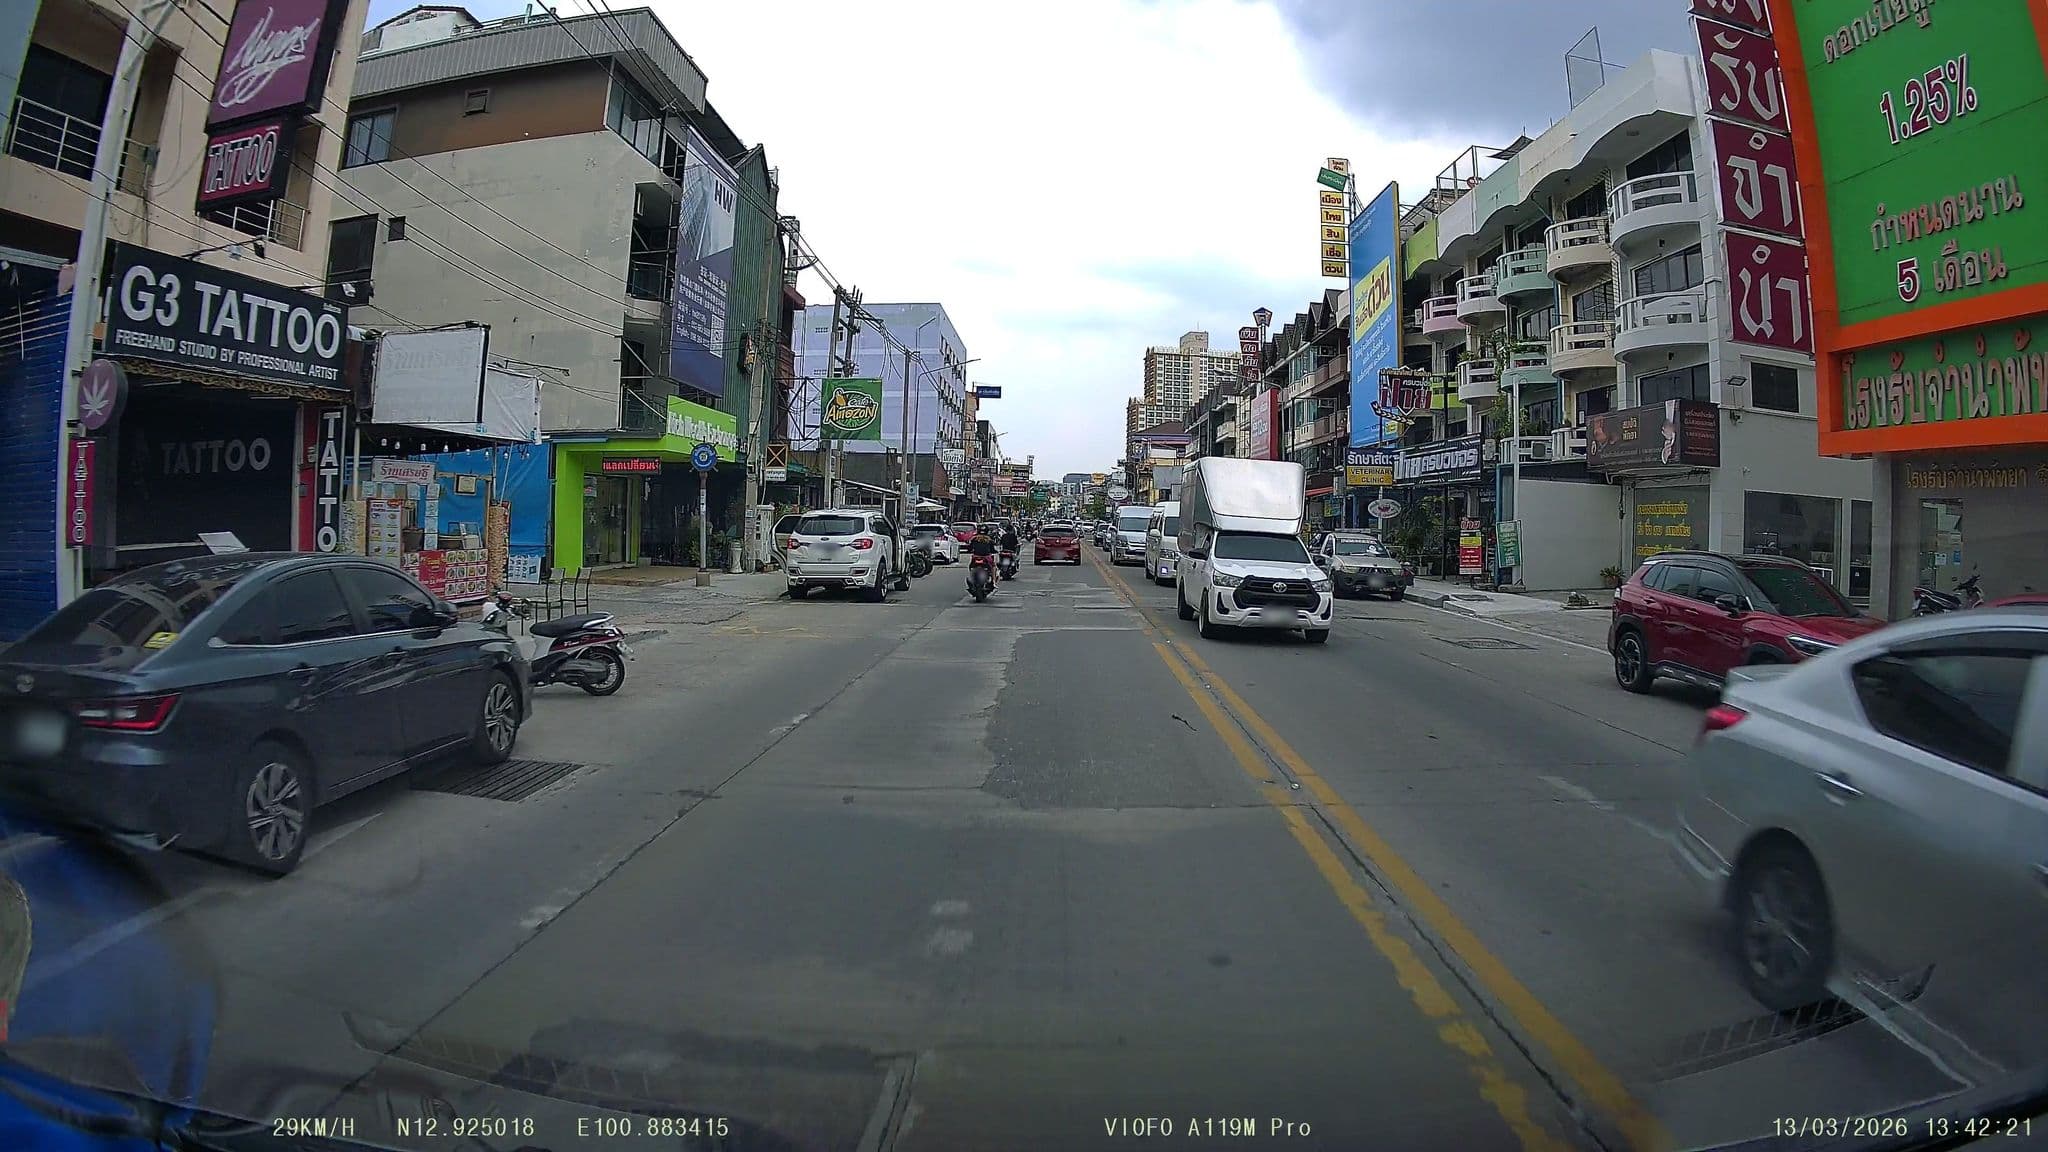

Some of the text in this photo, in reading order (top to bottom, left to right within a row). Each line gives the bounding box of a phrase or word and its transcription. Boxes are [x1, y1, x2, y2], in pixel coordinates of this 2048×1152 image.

[1708, 31, 1780, 121] รับ
[1879, 53, 1977, 145] 1.25%
[204, 131, 278, 193] TATTOO
[1726, 132, 1793, 227] จำ
[714, 179, 733, 214] HW
[1324, 210, 1342, 222] ไทย
[1870, 174, 2025, 251] กำหนดนาน
[1738, 243, 1803, 345] นำ
[1896, 239, 2008, 303] 5 เดือน
[121, 265, 341, 359] G3 TATTOO
[115, 328, 339, 381] FREEHAND STUDIO BY PROFESSIONAL ARTIST
[826, 405, 876, 422] Amazon
[160, 437, 271, 475] TATTOO
[1906, 462, 2027, 488] โรงรับจำนำพัทยา
[72, 441, 90, 543] TATTOO
